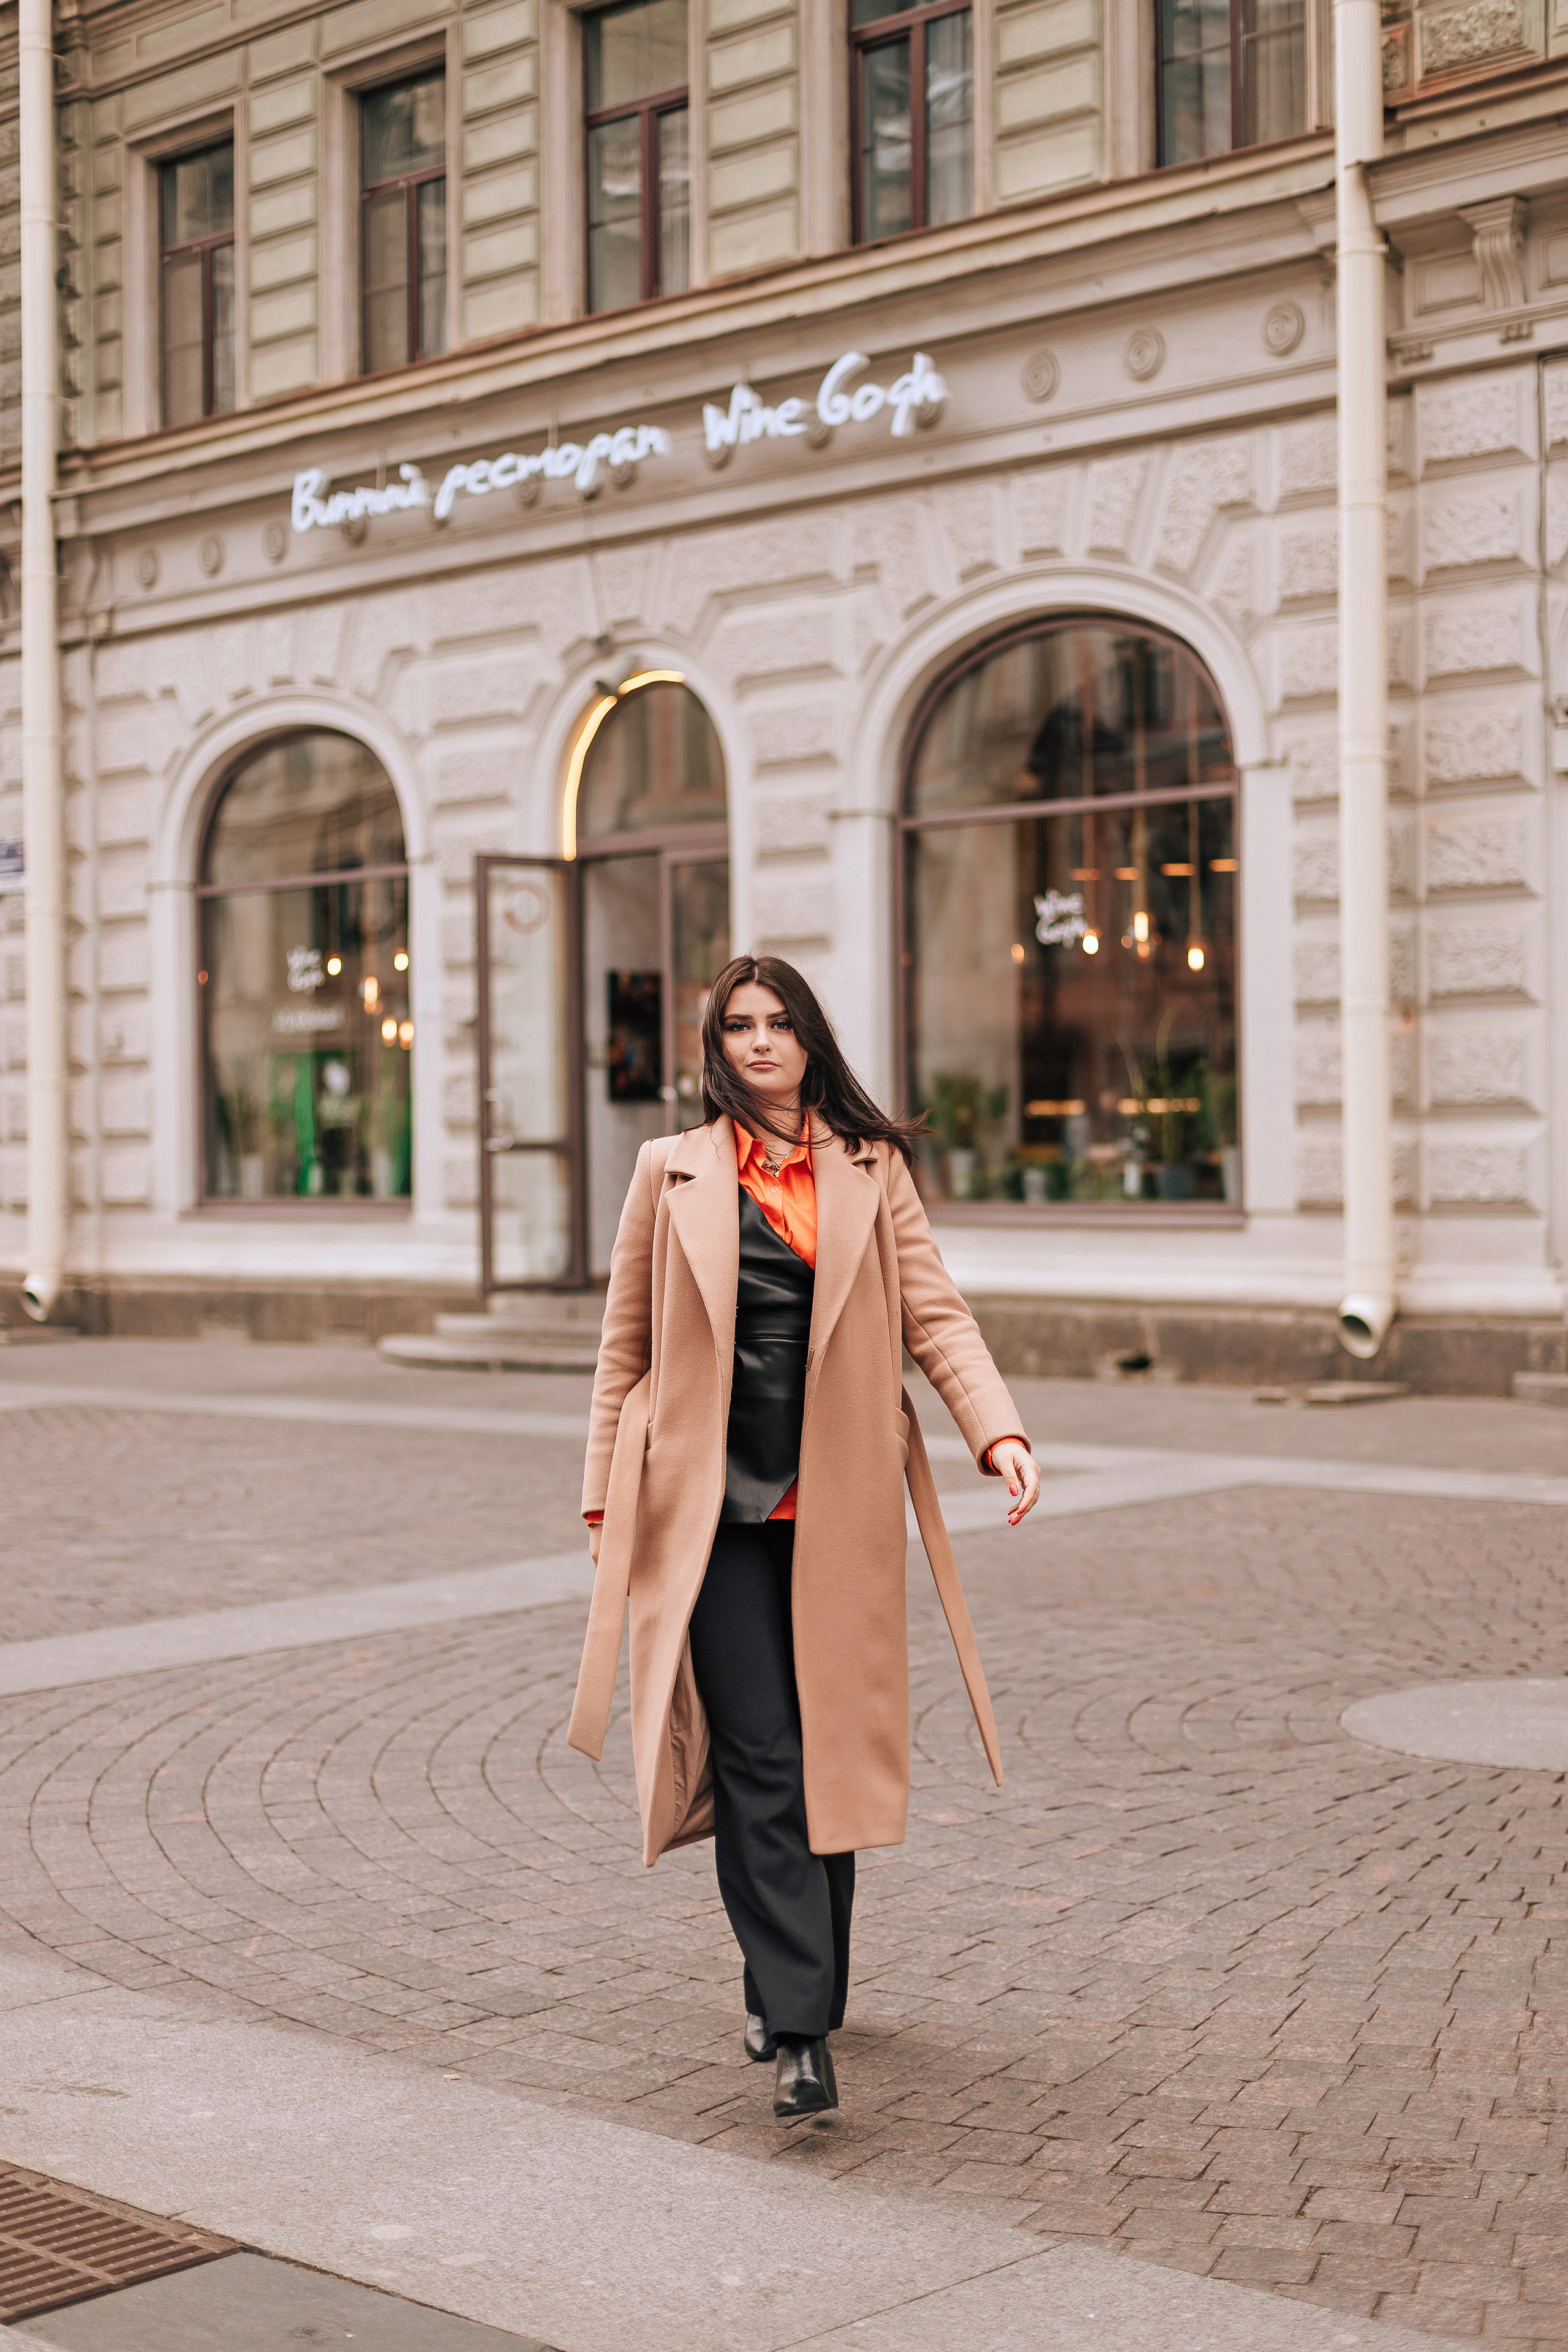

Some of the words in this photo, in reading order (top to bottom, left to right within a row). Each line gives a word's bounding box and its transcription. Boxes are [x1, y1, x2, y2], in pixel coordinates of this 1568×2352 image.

[702, 381, 807, 451] Wine
[816, 350, 949, 437] Gogh
[434, 424, 670, 519] ресторан
